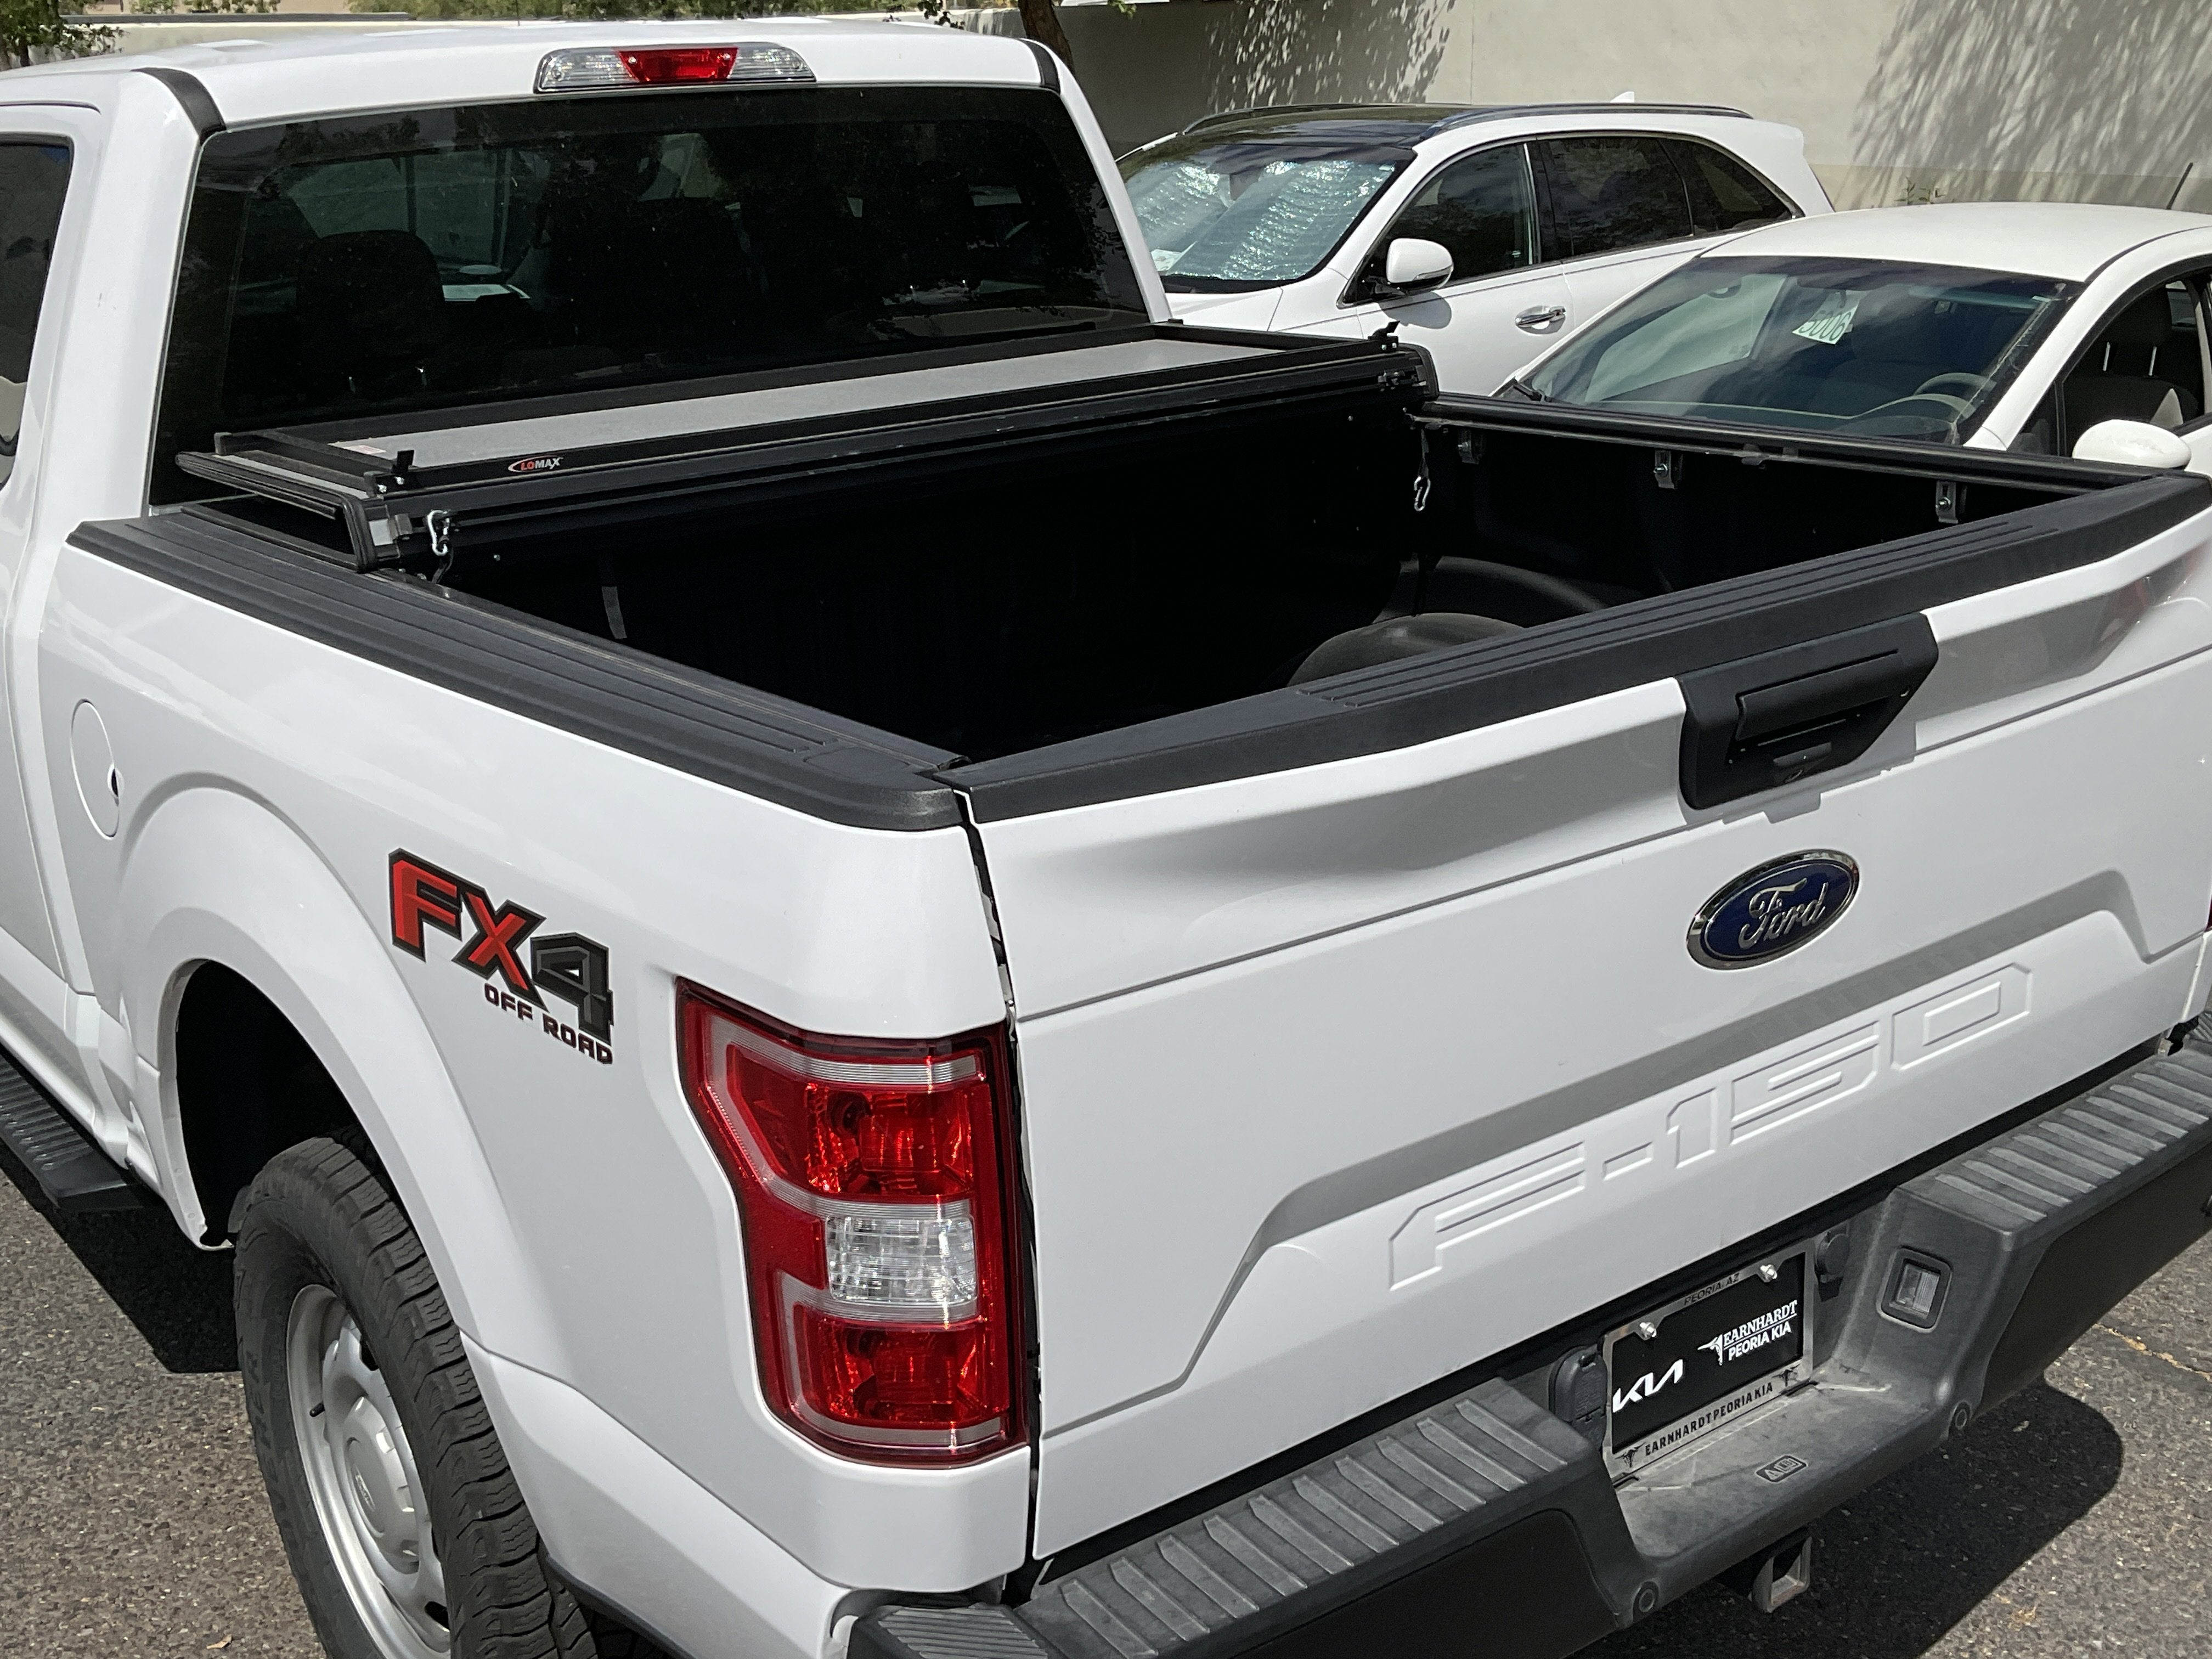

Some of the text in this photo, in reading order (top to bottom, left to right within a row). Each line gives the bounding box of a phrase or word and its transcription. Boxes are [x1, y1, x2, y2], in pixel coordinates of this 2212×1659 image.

[1798, 310, 1852, 341] 5006
[521, 457, 561, 471] LOMAX
[1738, 878, 1829, 949] Ford
[388, 848, 614, 1046] FX4
[484, 983, 613, 1064] OFF ROAD
[1389, 963, 2033, 1291] F-150
[1726, 1272, 1740, 1286] AZ
[1723, 1299, 1798, 1347] EARNHARDT
[1728, 1321, 1792, 1361] PEORIA KIA
